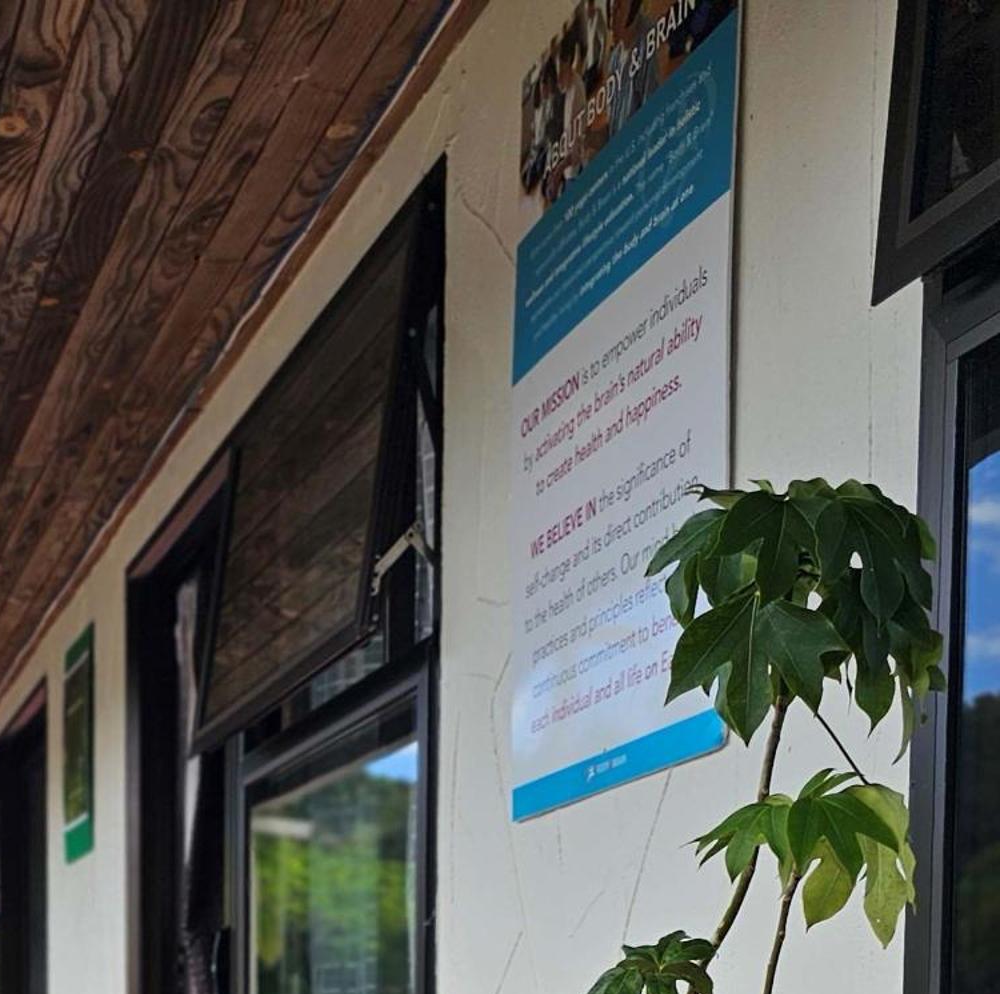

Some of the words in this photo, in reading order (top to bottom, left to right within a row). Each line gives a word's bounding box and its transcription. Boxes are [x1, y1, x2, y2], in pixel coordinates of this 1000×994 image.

[543, 110, 585, 178] ABOUT
[586, 69, 623, 125] BODY
[629, 47, 642, 77] &
[521, 408, 540, 438] OUR
[542, 372, 579, 419] MISSION
[582, 368, 588, 384] is
[602, 319, 648, 368] empower
[650, 266, 708, 328] individuals
[535, 418, 575, 461] activating
[577, 404, 592, 427] the
[594, 374, 625, 413] brain's
[628, 337, 664, 386] natural
[667, 315, 702, 355] ability
[547, 457, 573, 488] create
[575, 429, 603, 465] health
[605, 410, 623, 443] and
[626, 376, 682, 426] happiness.
[531, 534, 544, 558] WE
[547, 507, 583, 548] BELIEVE
[586, 498, 596, 520] IN
[599, 490, 615, 512] the
[616, 449, 676, 501] significance
[679, 429, 691, 458] of
[573, 539, 589, 567] and
[592, 538, 602, 554] its
[604, 517, 631, 547] direct
[634, 476, 699, 528] contribution
[533, 633, 568, 664] practices
[570, 617, 587, 643] and
[589, 592, 633, 637] principles
[534, 608, 547, 628] the
[549, 588, 573, 616] health
[576, 578, 585, 602] of
[587, 567, 618, 596] others.
[621, 552, 640, 575] Our
[594, 679, 612, 704] and
[627, 666, 642, 687] life
[645, 662, 658, 680] on
